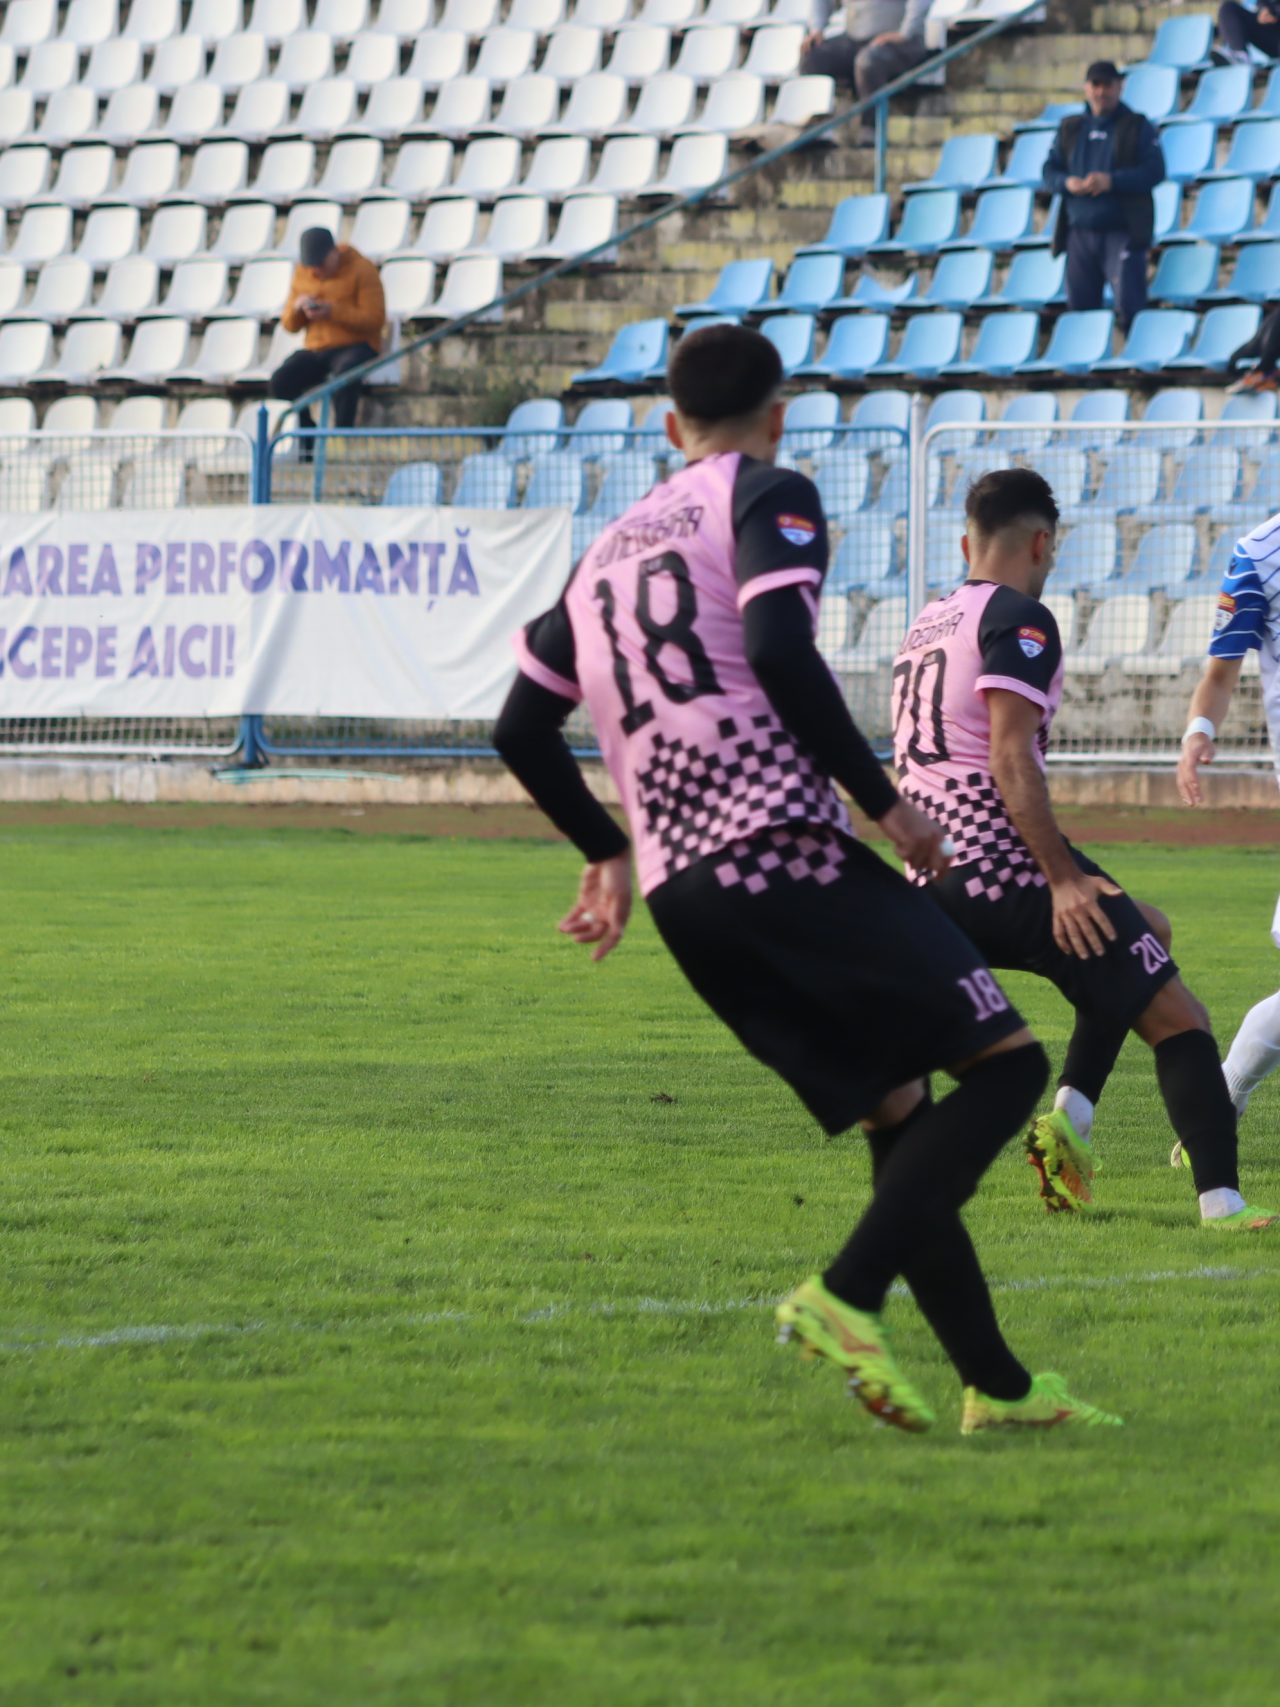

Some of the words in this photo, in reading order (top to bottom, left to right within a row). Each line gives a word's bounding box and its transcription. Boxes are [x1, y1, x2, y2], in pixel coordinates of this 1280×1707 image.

[135, 526, 481, 611] PERFORMANȚĂ
[0, 624, 117, 680] CEPE
[127, 624, 236, 680] AICI!
[594, 550, 726, 738] 18
[1128, 932, 1170, 976] 20
[956, 966, 1009, 1023] 18
